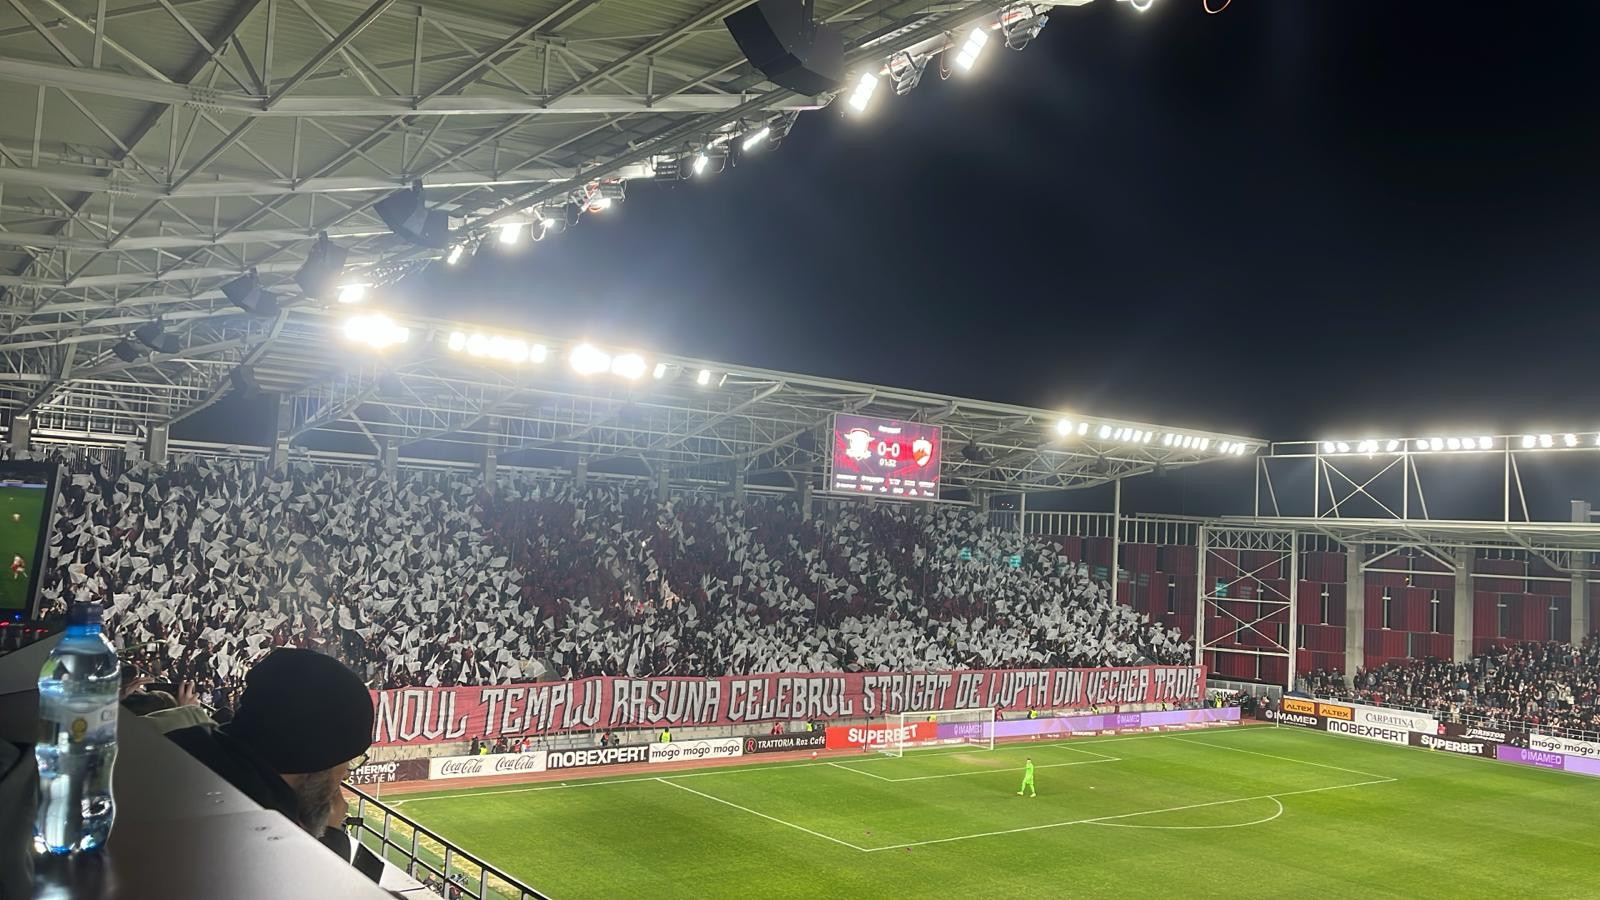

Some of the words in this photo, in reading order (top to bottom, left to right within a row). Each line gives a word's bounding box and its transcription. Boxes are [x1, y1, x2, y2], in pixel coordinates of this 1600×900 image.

[878, 441, 900, 457] 0-0
[373, 689, 468, 742] NOUL
[480, 679, 602, 735] TEMPLU
[609, 679, 721, 726] RASUNA
[862, 674, 952, 714] STRIGAT
[955, 673, 985, 709] DE
[987, 671, 1050, 708] LUPTA
[1052, 670, 1083, 706] DIN
[1153, 668, 1201, 700] TROIE
[1274, 711, 1317, 725] IMAMED
[1365, 712, 1414, 729] CARPATINA
[848, 724, 918, 743] SUPERBET
[1329, 720, 1407, 742] MOBEXPERT
[651, 745, 680, 760] mogo
[683, 744, 710, 758] mogo
[713, 740, 740, 754] mogo
[758, 739, 794, 749] TRATTORIA
[1420, 735, 1484, 753] SUPERBET
[1531, 740, 1561, 751] mogo
[1564, 744, 1594, 755] mogo
[547, 746, 649, 768] MOBEXPERT
[1527, 751, 1562, 765] IMAMED
[348, 773, 396, 785] SYSTEM
